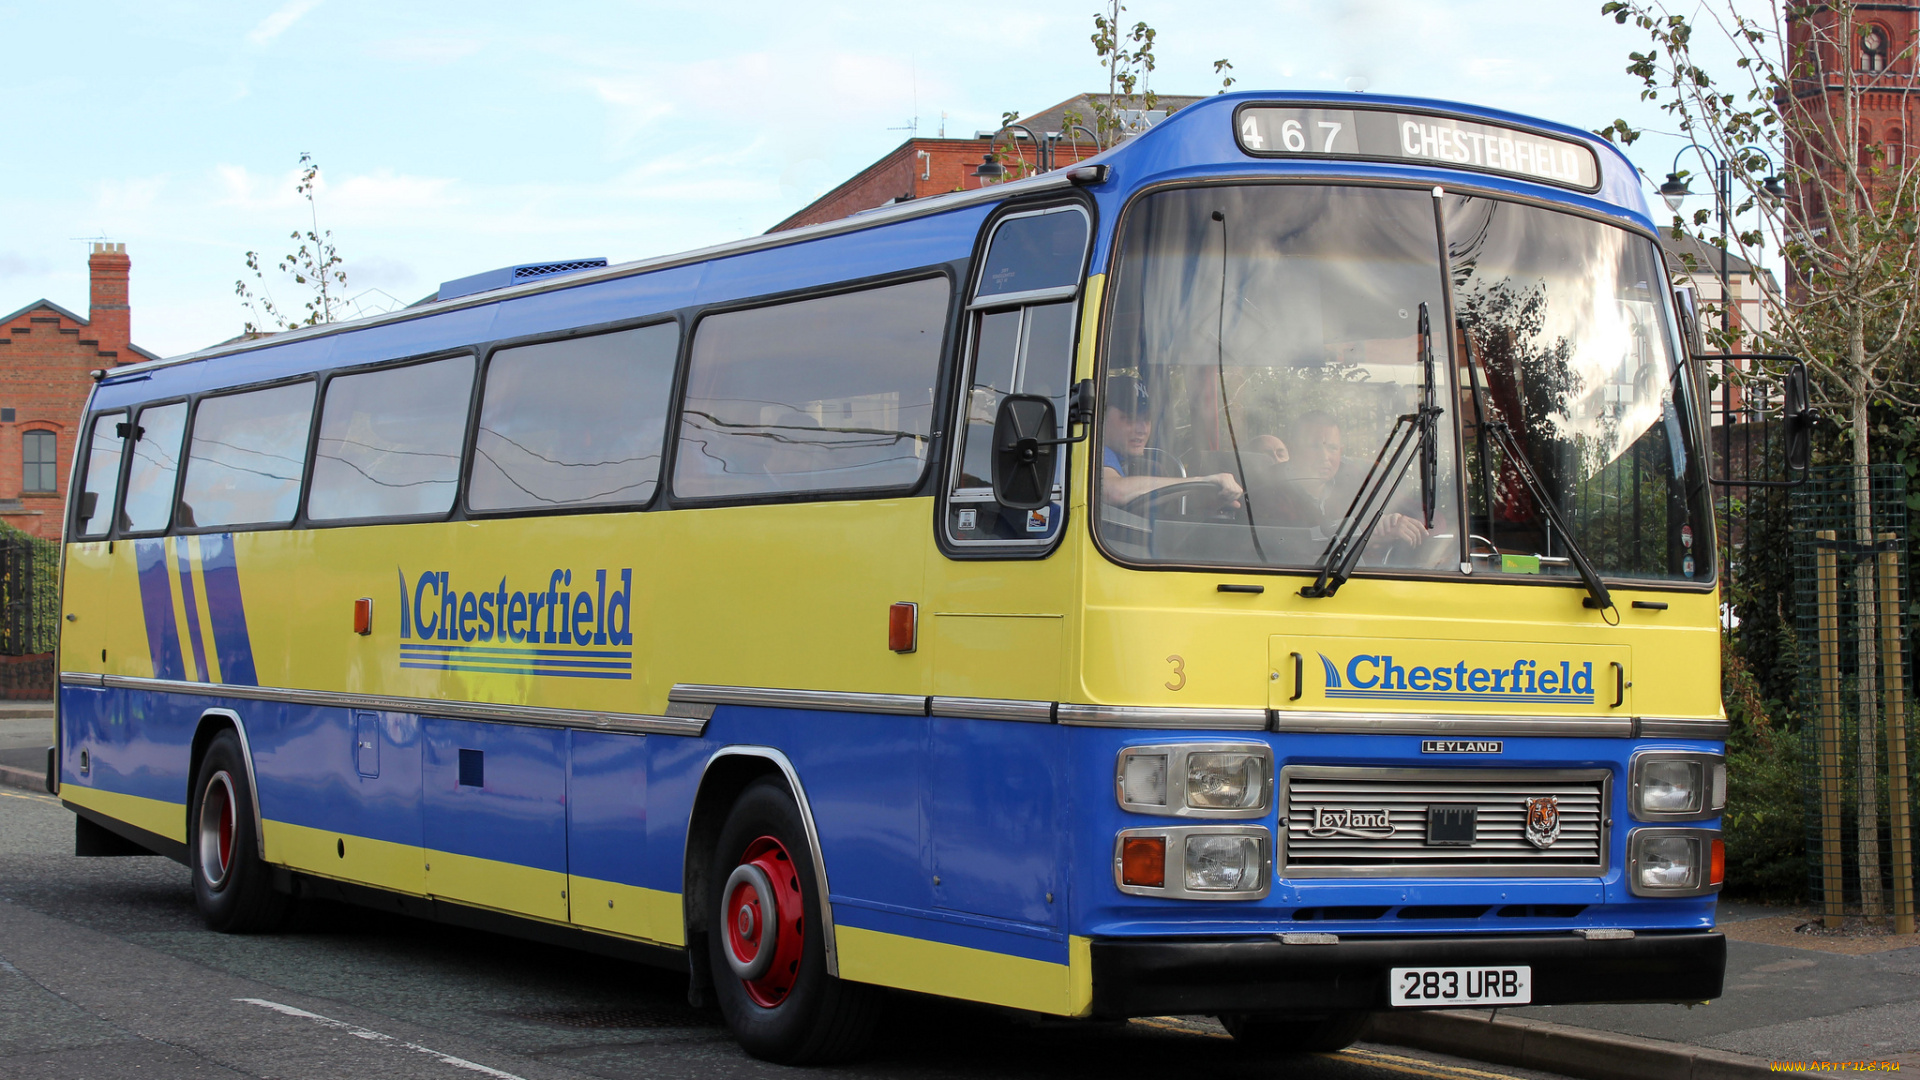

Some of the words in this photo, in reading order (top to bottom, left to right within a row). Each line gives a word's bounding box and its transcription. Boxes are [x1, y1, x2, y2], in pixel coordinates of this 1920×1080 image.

[1403, 120, 1580, 182] CHESTERFIELD
[414, 568, 633, 647] Chesterfield
[1165, 654, 1187, 692] 3
[1346, 654, 1595, 695] Chesterfield
[1427, 742, 1499, 752] LEYLAND
[1308, 805, 1396, 838] Leyland
[1404, 971, 1459, 999] 283
[1466, 970, 1518, 998] URB
